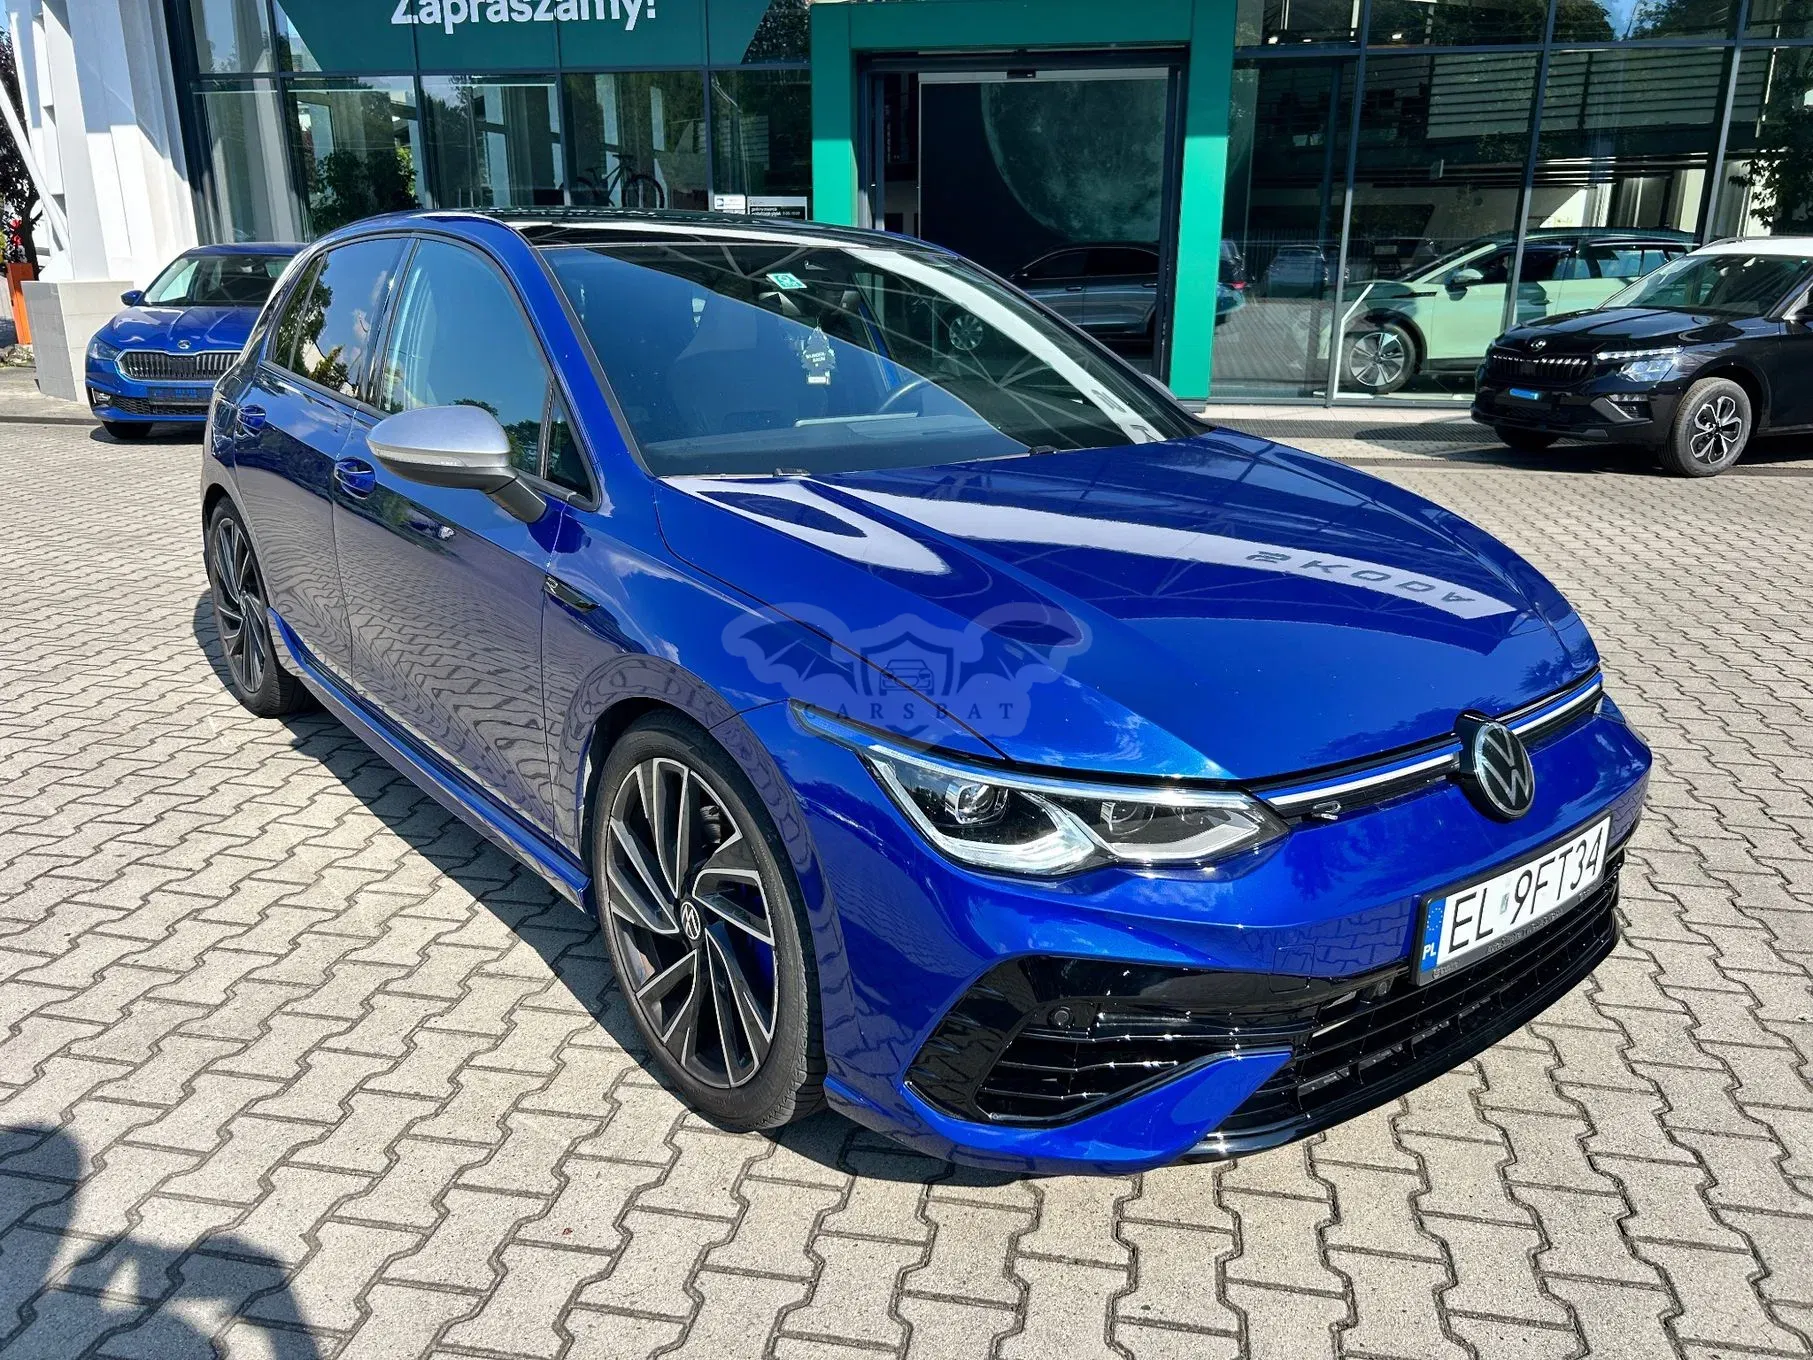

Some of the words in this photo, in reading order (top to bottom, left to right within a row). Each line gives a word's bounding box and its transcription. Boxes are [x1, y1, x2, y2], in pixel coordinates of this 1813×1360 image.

[391, 0, 657, 34] Zapraszamy!
[1448, 888, 1494, 954] EL
[1510, 826, 1603, 925] 9FT34
[1422, 943, 1437, 960] PL
